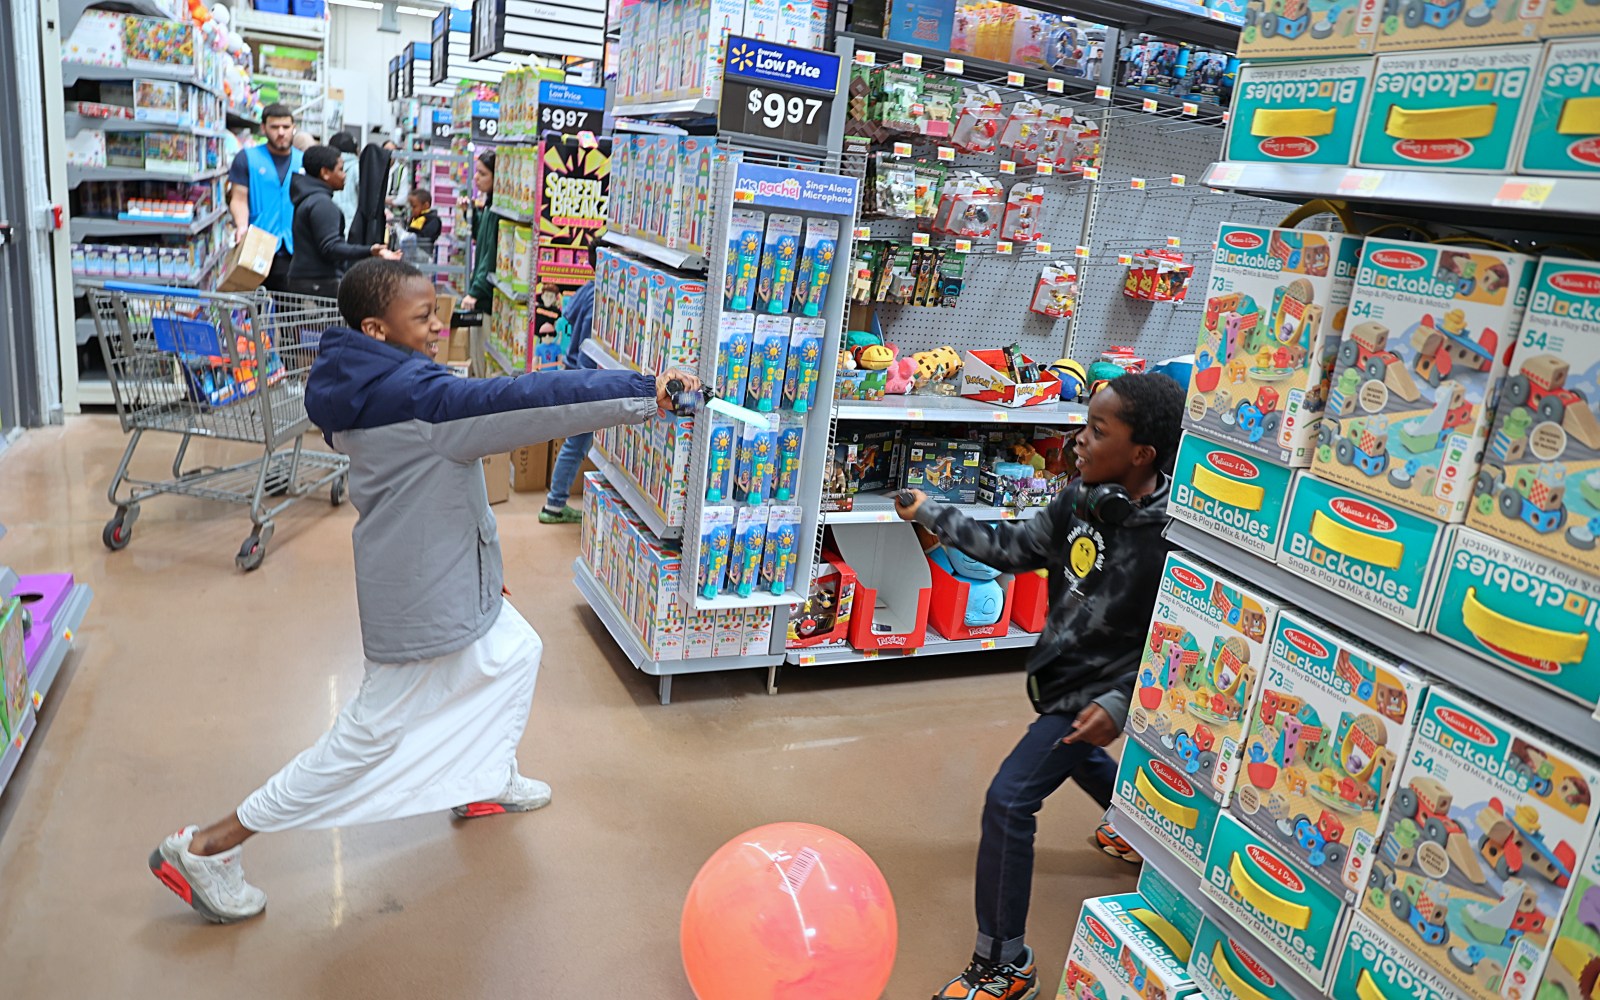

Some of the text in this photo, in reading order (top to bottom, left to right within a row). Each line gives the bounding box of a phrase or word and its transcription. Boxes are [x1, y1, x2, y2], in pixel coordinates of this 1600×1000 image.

[756, 54, 785, 72] Low
[786, 59, 821, 78] Price
[1244, 79, 1357, 104] Blockables
[1375, 70, 1528, 98] Blockables
[760, 180, 801, 199] Rachel
[805, 180, 853, 197] Sing-Along
[802, 189, 853, 204] Microphone
[1216, 248, 1283, 270] Blockables
[1212, 277, 1225, 292] 73
[1358, 267, 1455, 298] Blockables
[1352, 300, 1372, 318] 54
[1522, 329, 1548, 351] 54
[1211, 453, 1235, 469] Melissa
[1239, 463, 1253, 477] Doug
[1176, 484, 1269, 539] Blockables
[1336, 500, 1365, 519] Melissa
[1371, 513, 1389, 529] Doug
[1175, 505, 1266, 551] Snap & Play Mix & Match
[1462, 536, 1500, 559] Match
[1501, 550, 1511, 562] &
[1290, 532, 1410, 602] Blockables
[1513, 554, 1536, 573] Mix
[1288, 556, 1404, 616] Snap & Play Mix & Match
[1549, 568, 1578, 588] Play
[1157, 602, 1170, 619] 73
[1161, 576, 1223, 621] Blockables
[1268, 667, 1284, 687] 73
[1273, 638, 1351, 694] Blockables
[1271, 656, 1286, 670] Snap
[1291, 667, 1305, 681] Play
[1309, 678, 1321, 689] Mix
[1327, 688, 1347, 704] Match
[1411, 750, 1434, 774] 54
[1420, 717, 1530, 793] Blockables
[1418, 737, 1524, 802] Snap & Play Mix & Match
[1120, 780, 1204, 856] Blockables
[1119, 798, 1200, 867] Snap & Play Mix & Match
[1103, 901, 1186, 975] Blockables
[1209, 885, 1312, 973] Snap & Play Mix & Match
[1355, 920, 1388, 950] Match
[1072, 943, 1084, 961] 73
[1077, 922, 1131, 984] Blockables
[1399, 951, 1418, 974] Mix
